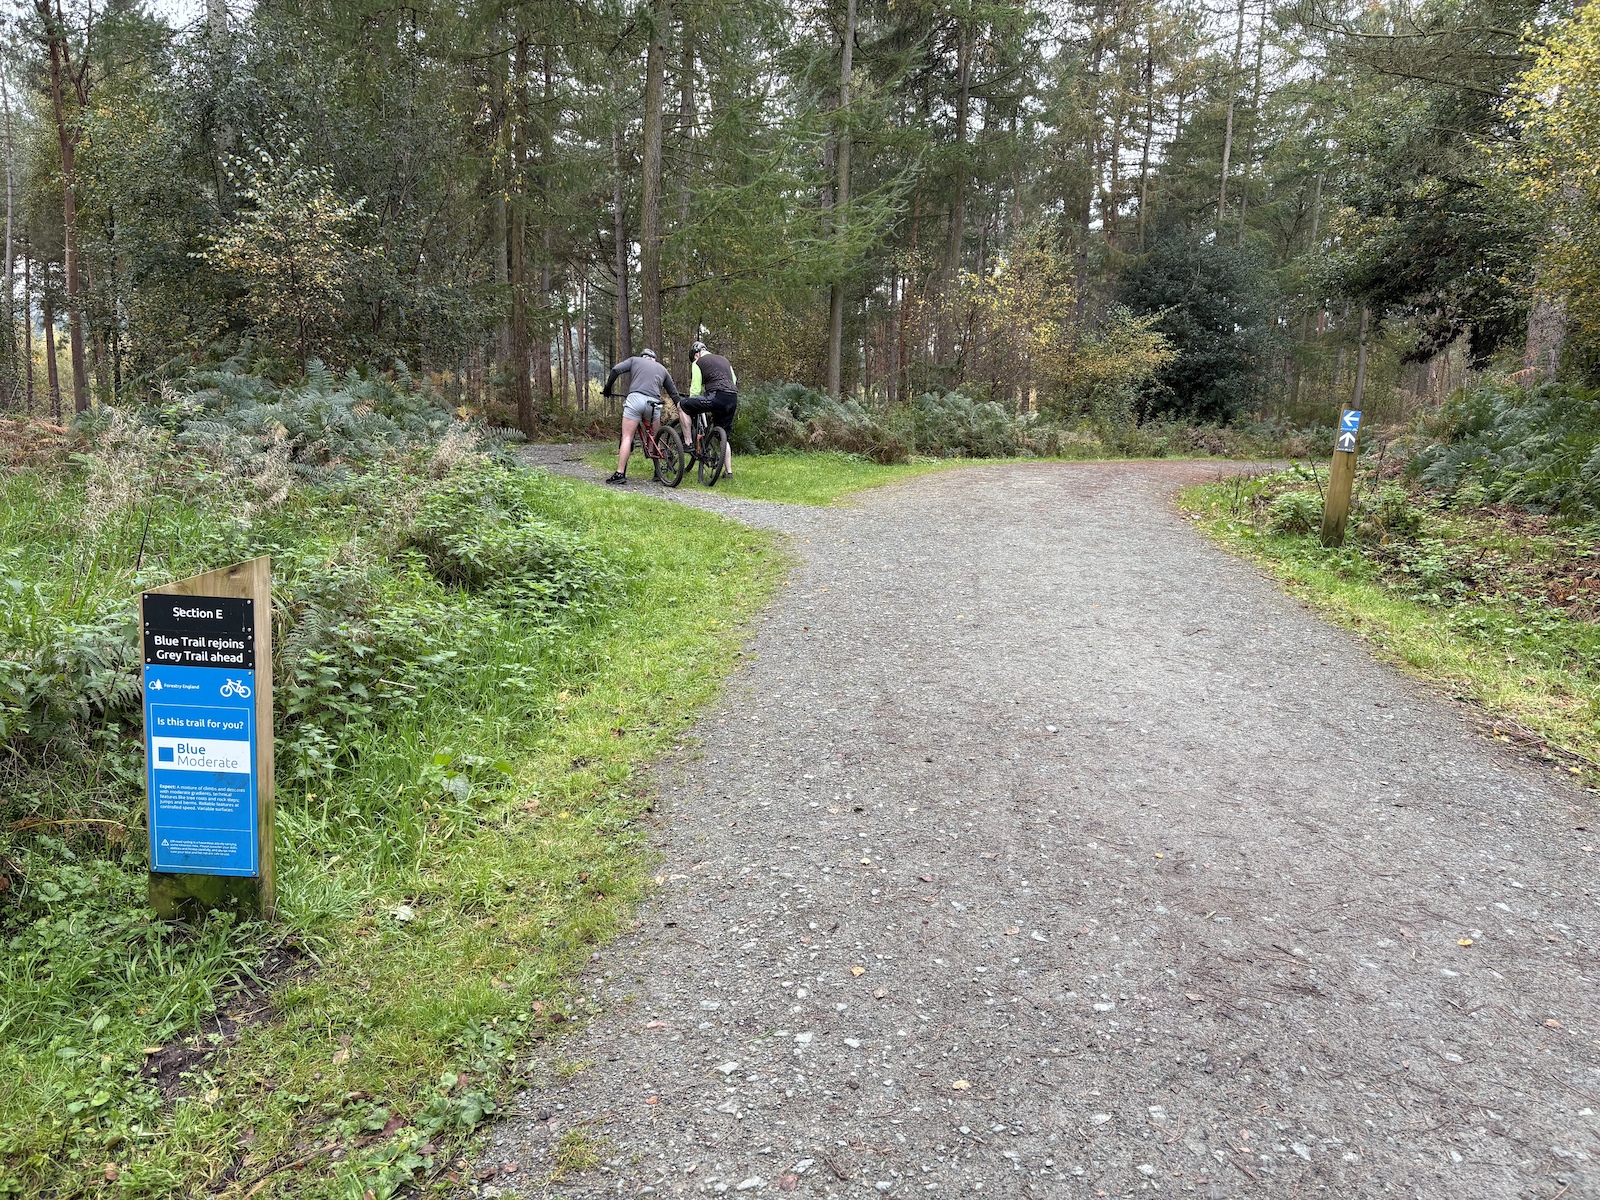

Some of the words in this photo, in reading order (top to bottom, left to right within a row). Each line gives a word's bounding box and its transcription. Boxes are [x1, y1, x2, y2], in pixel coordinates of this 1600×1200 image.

[172, 606, 213, 619] Section
[215, 609, 223, 619] E
[154, 635, 179, 646] Blue
[180, 636, 206, 647] Trail
[207, 638, 245, 650] rejoins
[156, 650, 182, 662] Grey
[183, 651, 209, 662] Trail
[210, 652, 244, 663] ahead
[157, 717, 166, 726] Is
[167, 717, 184, 727] this
[186, 718, 205, 728] trail
[207, 719, 221, 728] for
[222, 721, 244, 730] you?
[177, 743, 206, 755] Blue
[177, 755, 238, 768] Moderate
